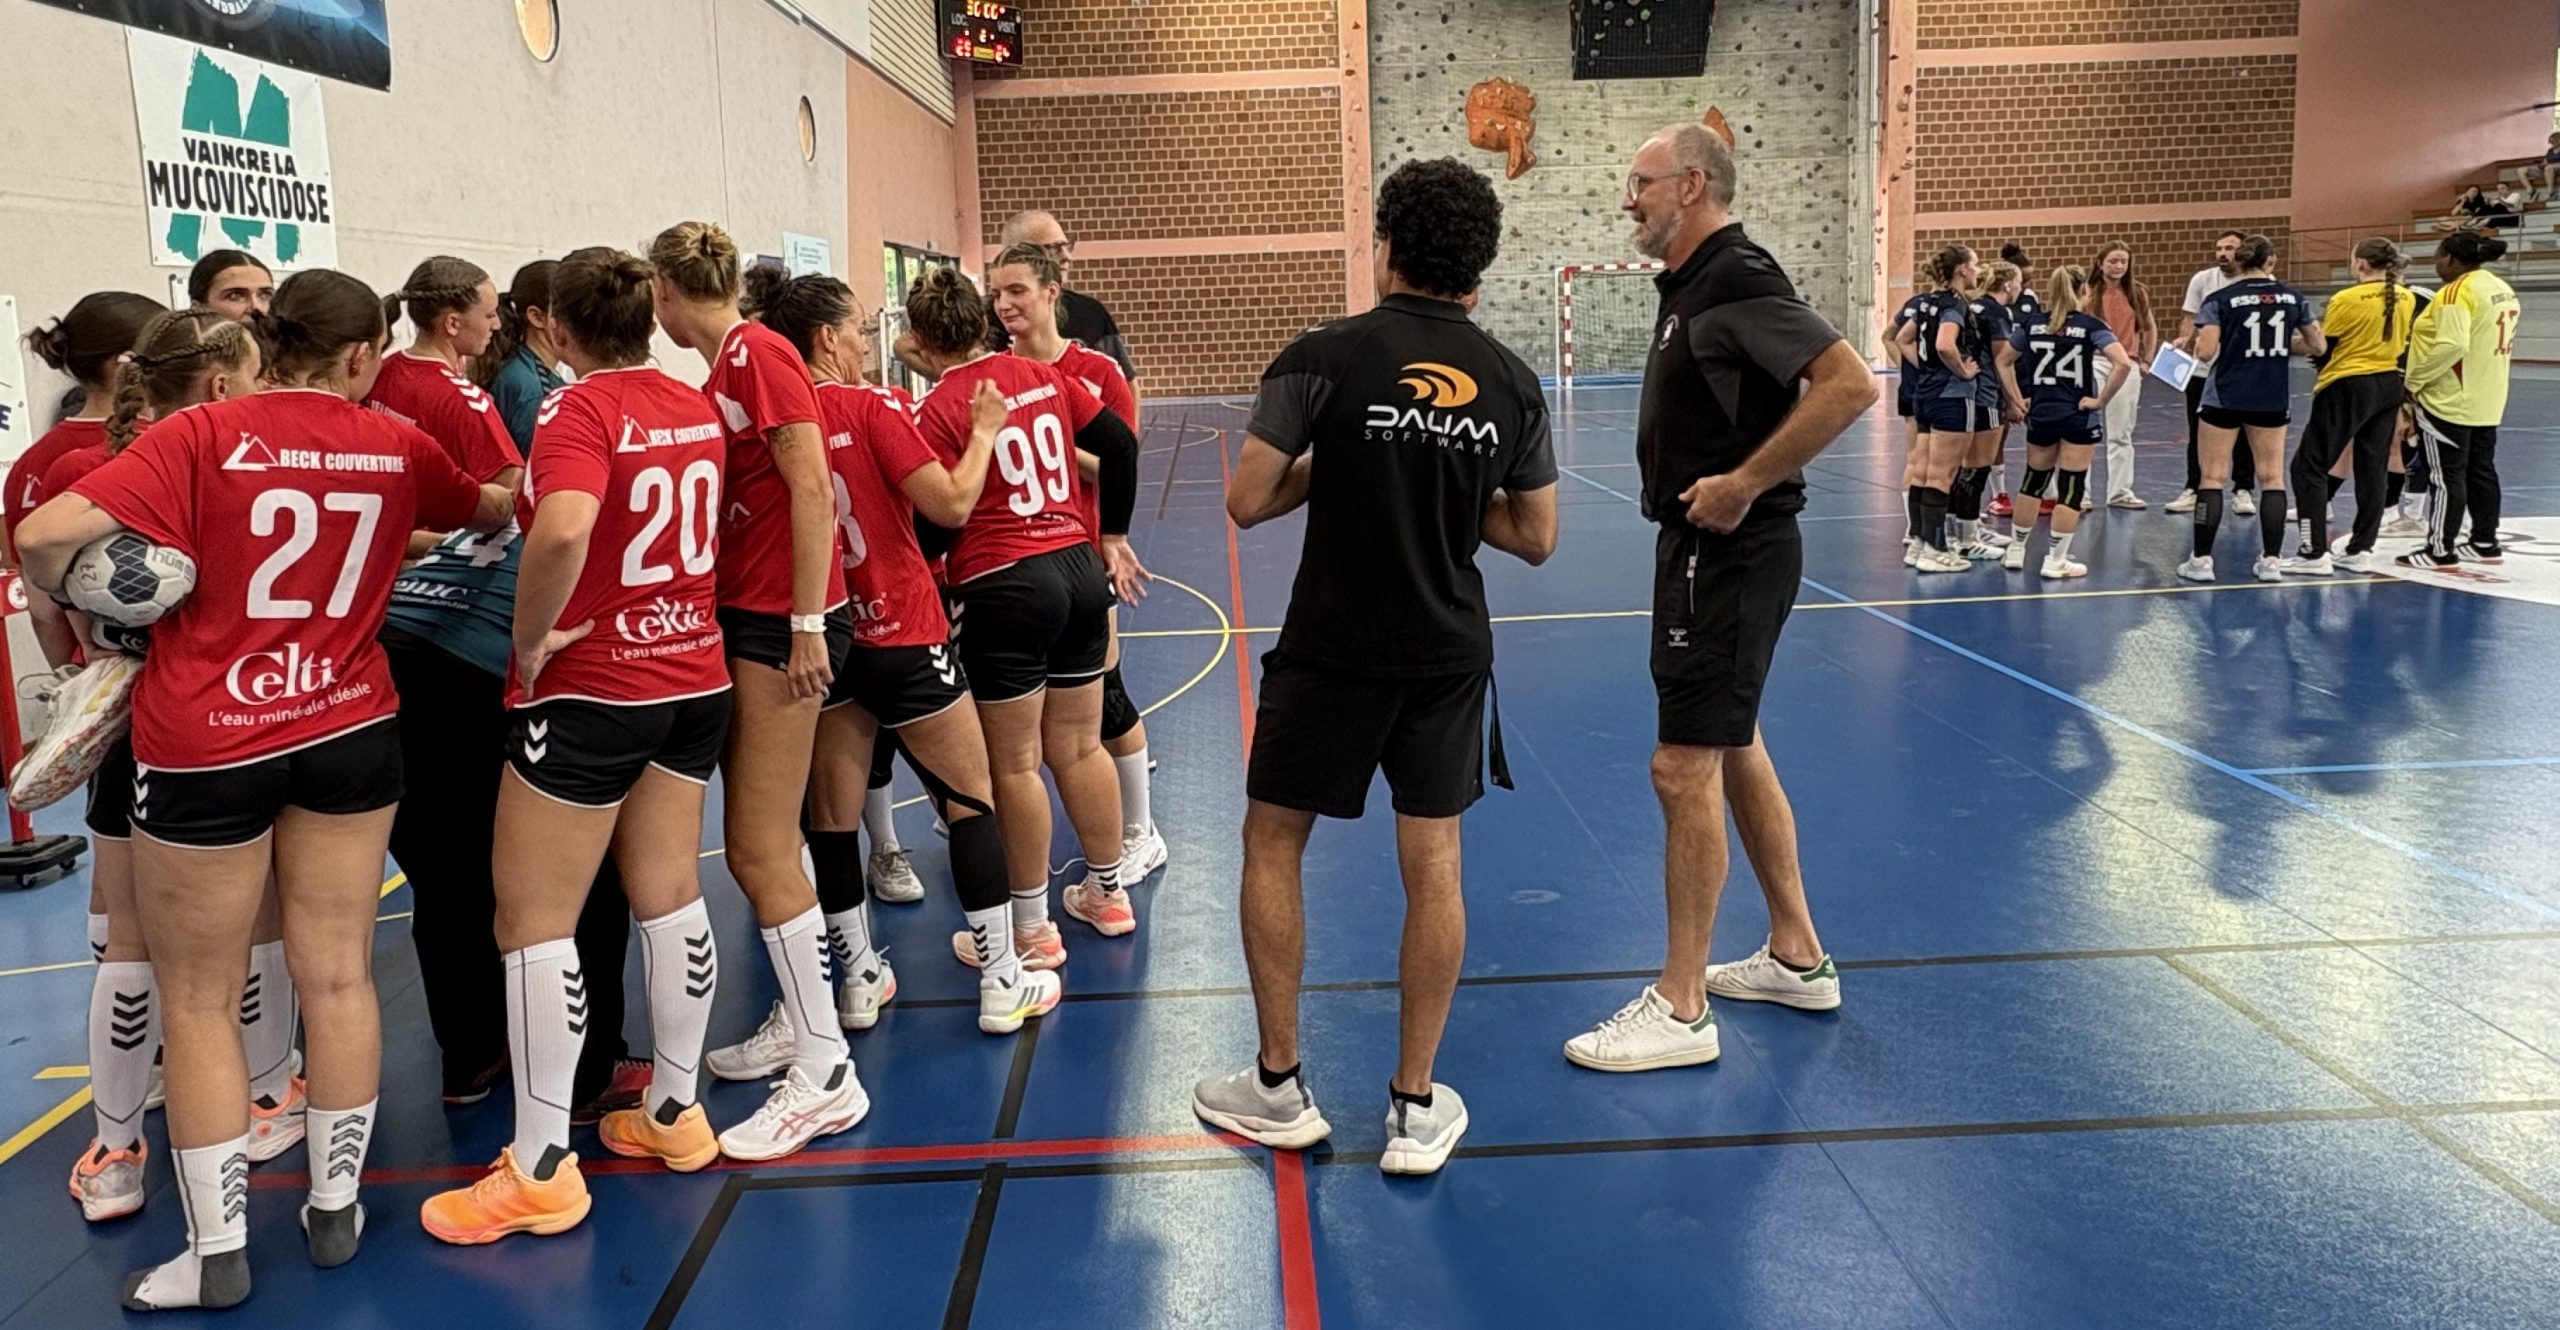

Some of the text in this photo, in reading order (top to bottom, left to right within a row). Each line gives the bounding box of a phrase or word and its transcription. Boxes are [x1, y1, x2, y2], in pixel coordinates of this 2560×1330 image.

[182, 136, 298, 178] VAINCRE LA
[147, 159, 330, 224] MUCOVISCIDOSE
[2243, 310, 2288, 358] 11
[2030, 341, 2084, 388] 24
[1364, 428, 1498, 458] SOFTWARE
[1366, 405, 1499, 445] DALIM
[280, 448, 405, 473] BECK COUVERTURE
[994, 413, 1070, 517] 99
[620, 460, 719, 587] 20
[246, 488, 383, 619] 27
[615, 596, 708, 644] Celtic
[226, 642, 347, 706] Celti
[611, 648, 650, 661] L'eau
[208, 711, 255, 727] L'eau
